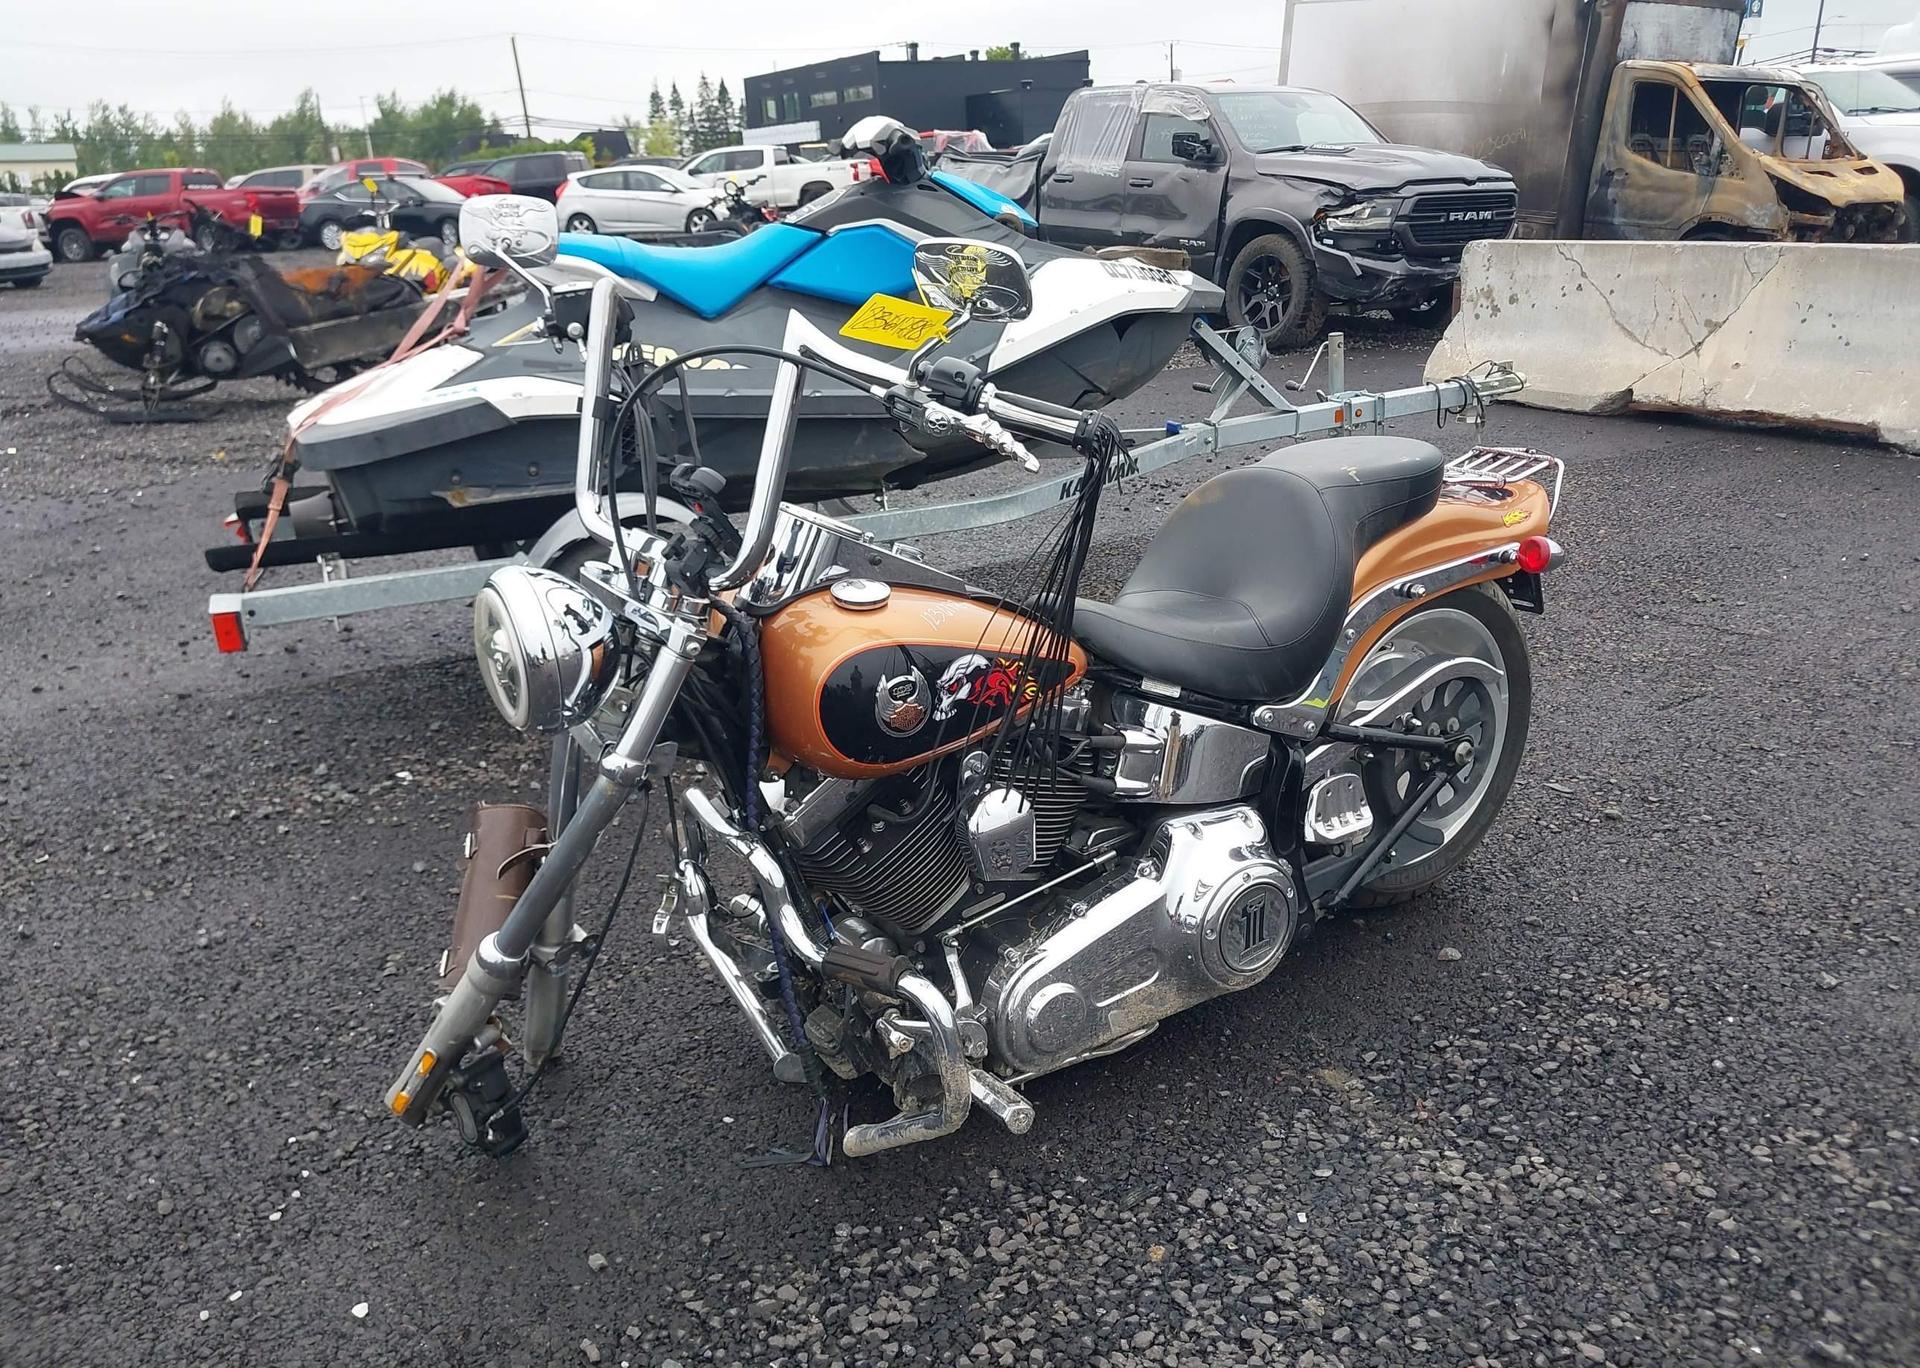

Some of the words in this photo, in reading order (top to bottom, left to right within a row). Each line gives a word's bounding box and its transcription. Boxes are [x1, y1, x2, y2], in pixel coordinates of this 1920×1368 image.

[1449, 211, 1492, 221] RAM
[1179, 239, 1206, 247] RAM
[1060, 458, 1138, 500] KAVAN
